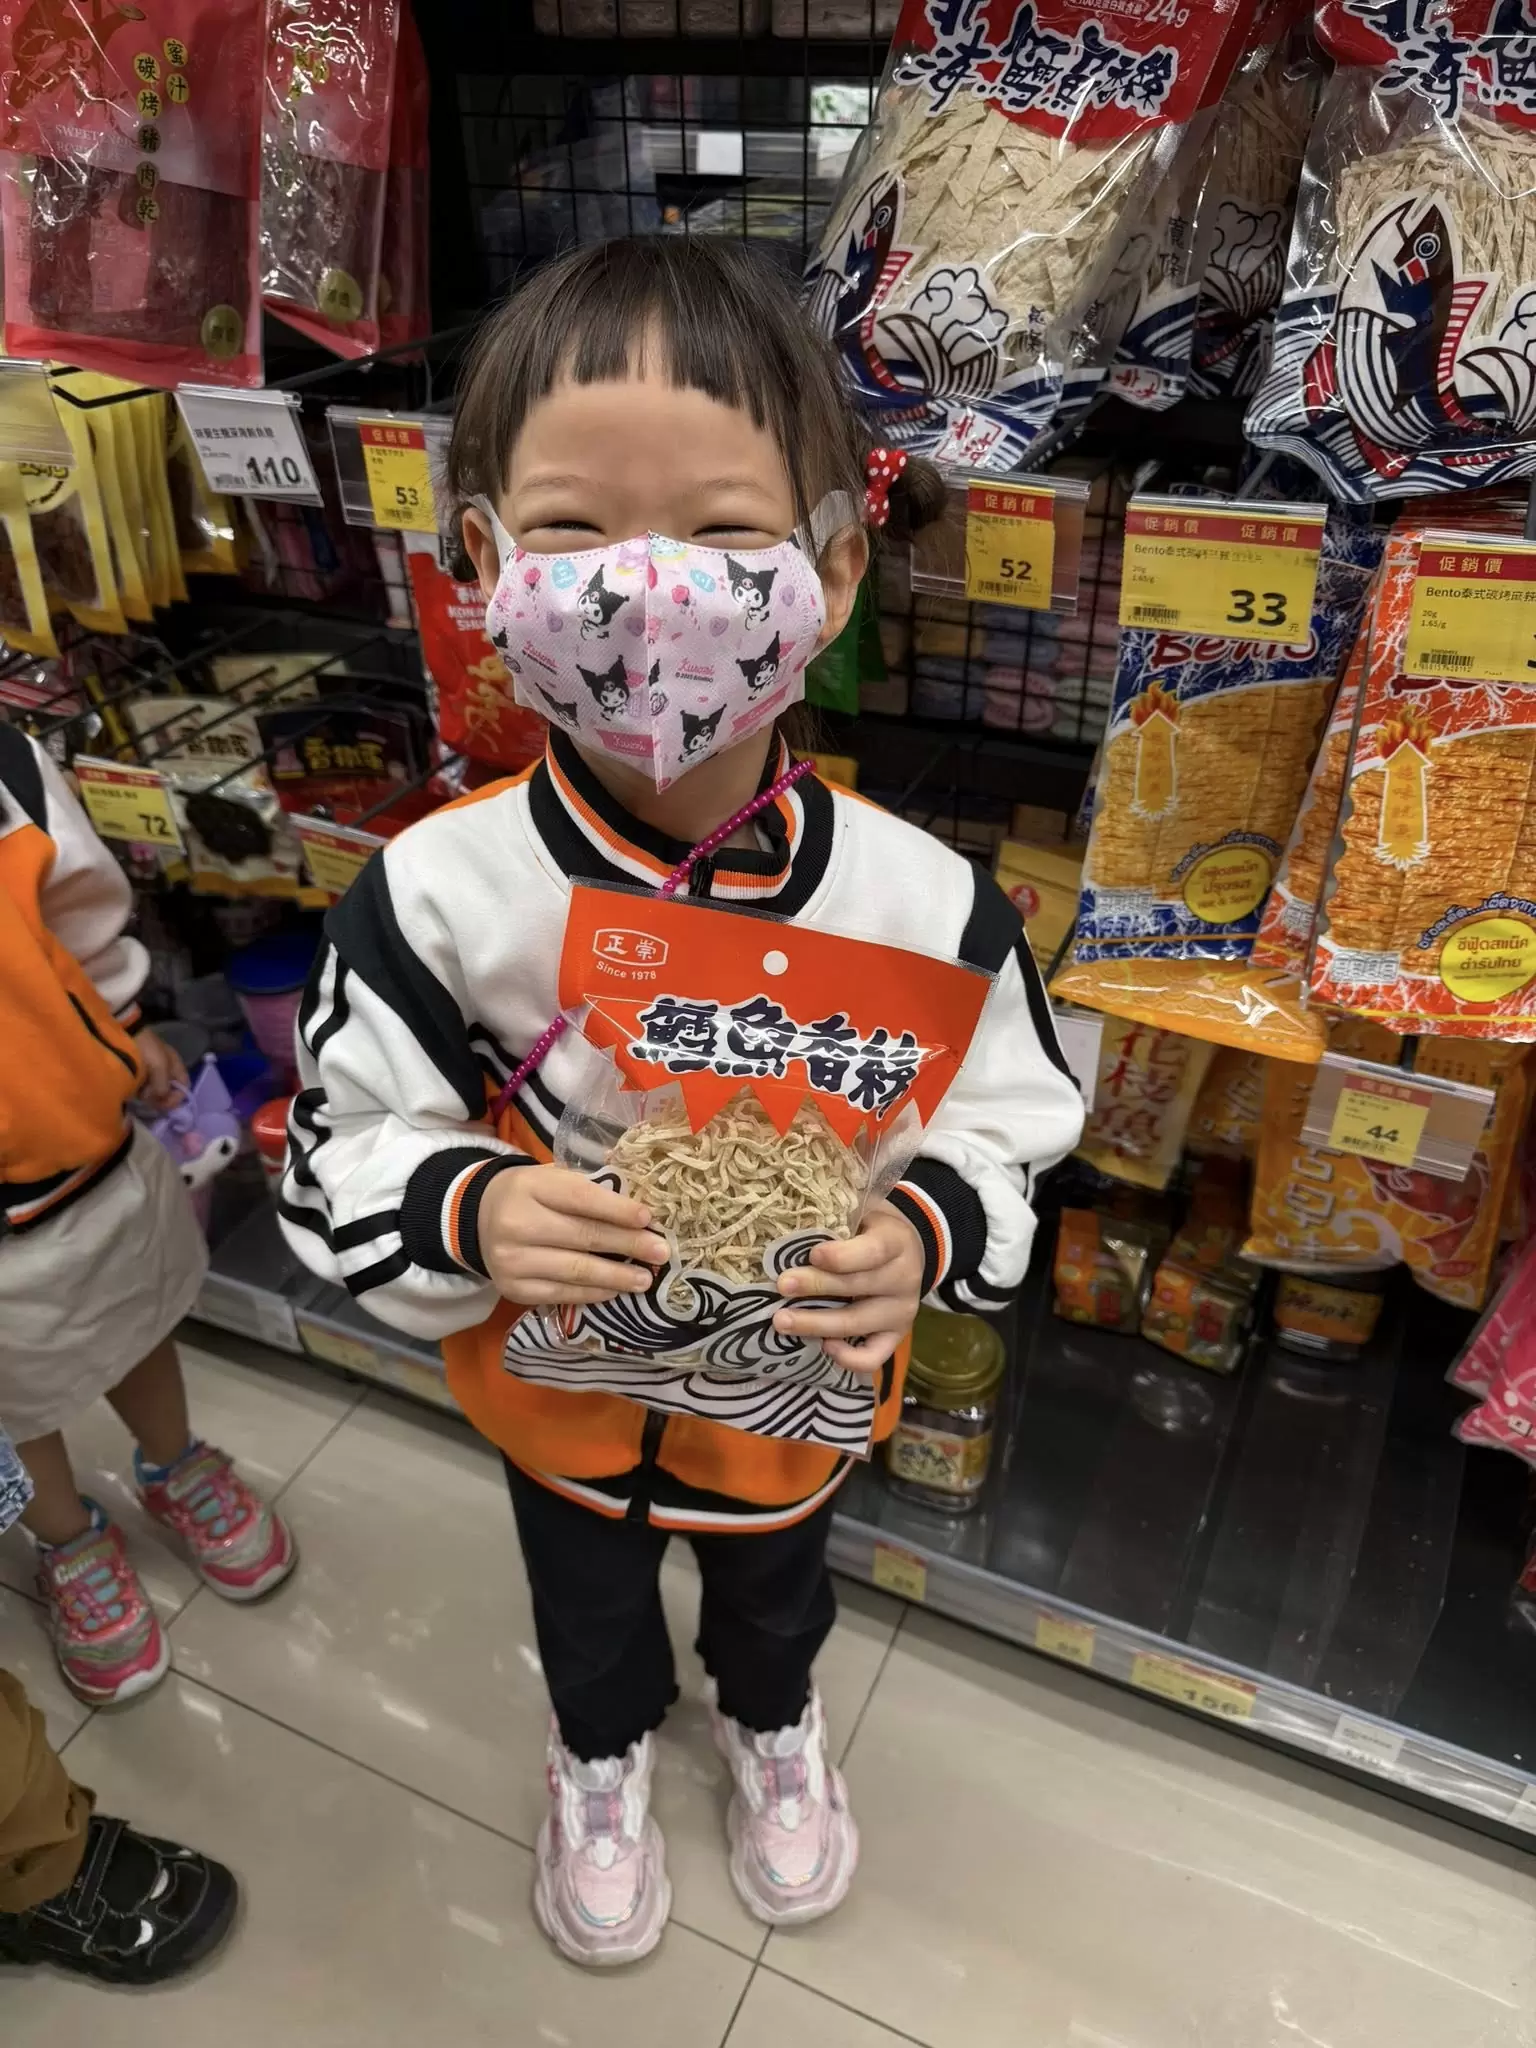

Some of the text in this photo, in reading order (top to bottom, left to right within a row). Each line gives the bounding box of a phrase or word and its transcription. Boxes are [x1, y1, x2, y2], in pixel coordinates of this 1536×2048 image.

[166, 40, 186, 101] 蜜汁
[246, 456, 302, 485] 110
[395, 486, 420, 506] 53
[984, 493, 1037, 514] 促銷價
[1143, 516, 1200, 534] 促銷價
[1240, 523, 1300, 543] 促銷價
[1000, 557, 1033, 581] 52
[1439, 555, 1503, 574] 促銷價
[1226, 589, 1288, 627] 33
[1422, 609, 1438, 618] 20g
[1421, 620, 1447, 629] 1.65/g
[137, 813, 173, 836] 72
[603, 934, 657, 960] 正崇
[596, 960, 657, 981] Since 1978
[1365, 1125, 1400, 1143] 44
